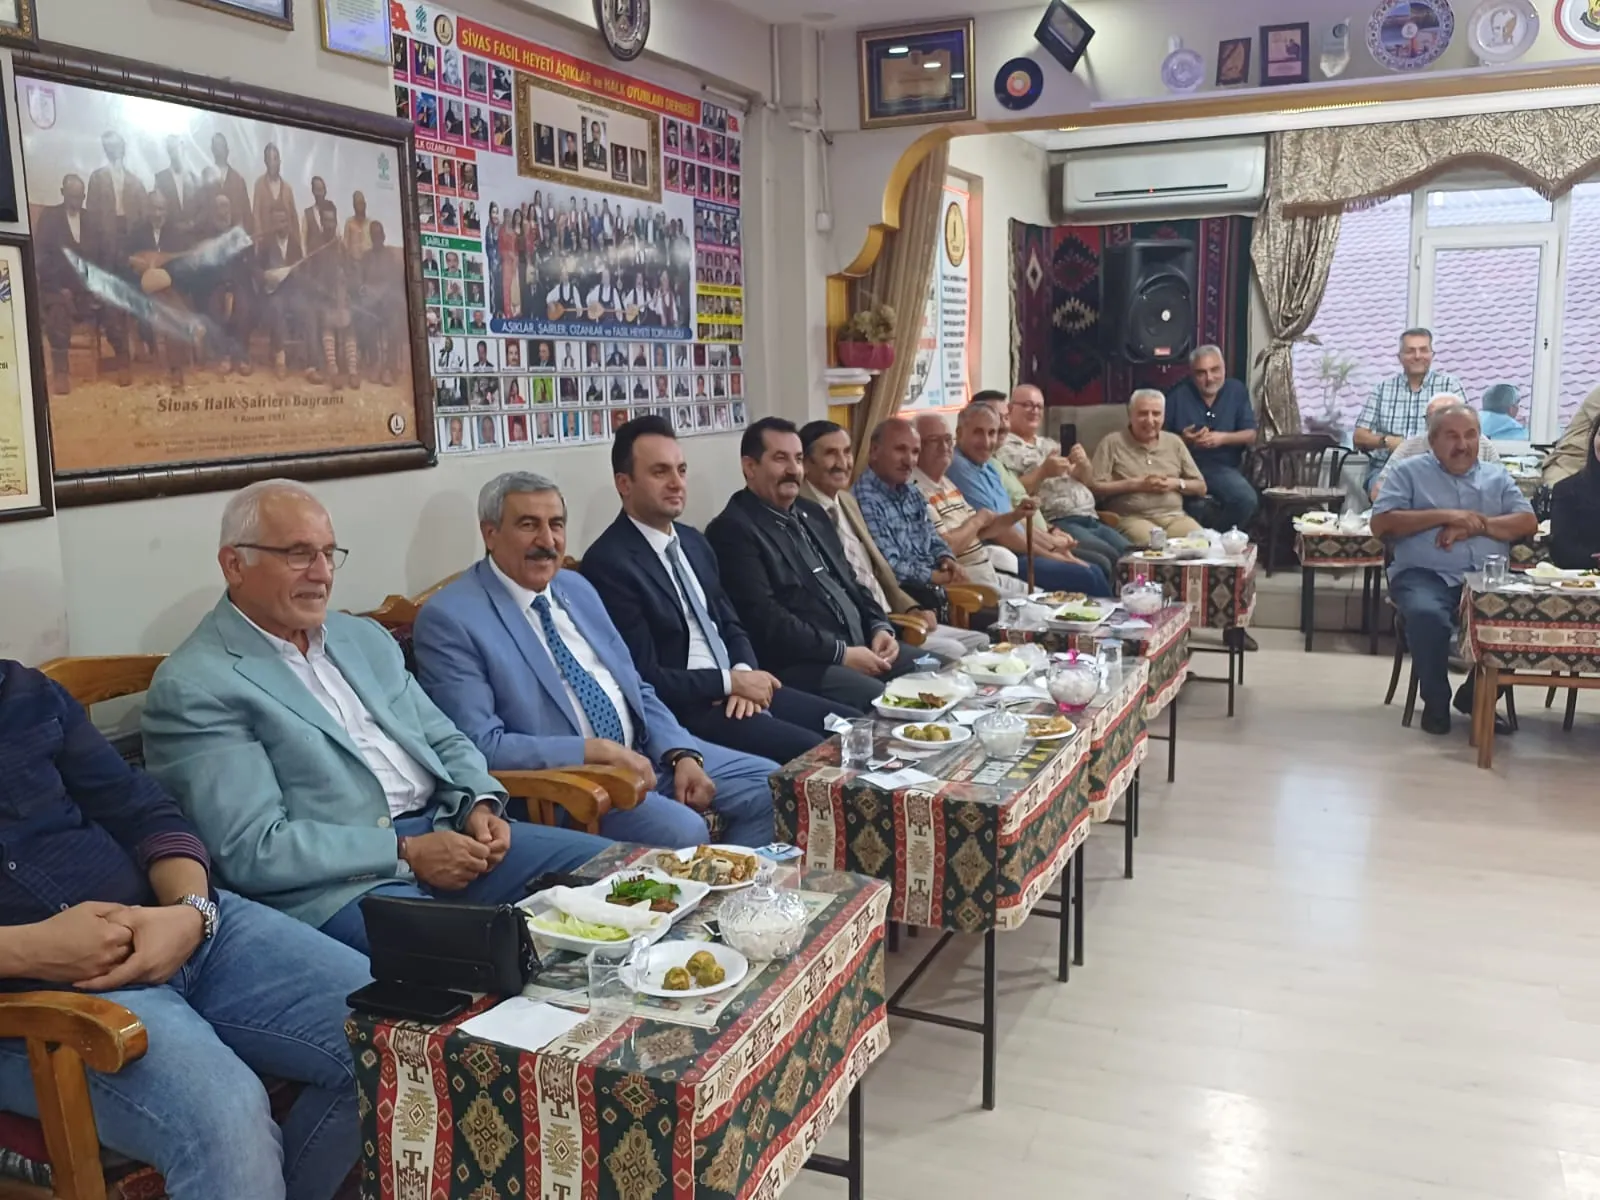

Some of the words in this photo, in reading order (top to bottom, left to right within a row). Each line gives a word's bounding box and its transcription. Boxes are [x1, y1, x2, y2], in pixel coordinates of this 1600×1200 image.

[462, 28, 491, 52] SİVAS
[493, 39, 521, 62] FASIL
[522, 49, 554, 73] HEYETİ
[604, 78, 626, 96] HALK
[157, 397, 199, 412] Sivas
[204, 398, 236, 411] Halk
